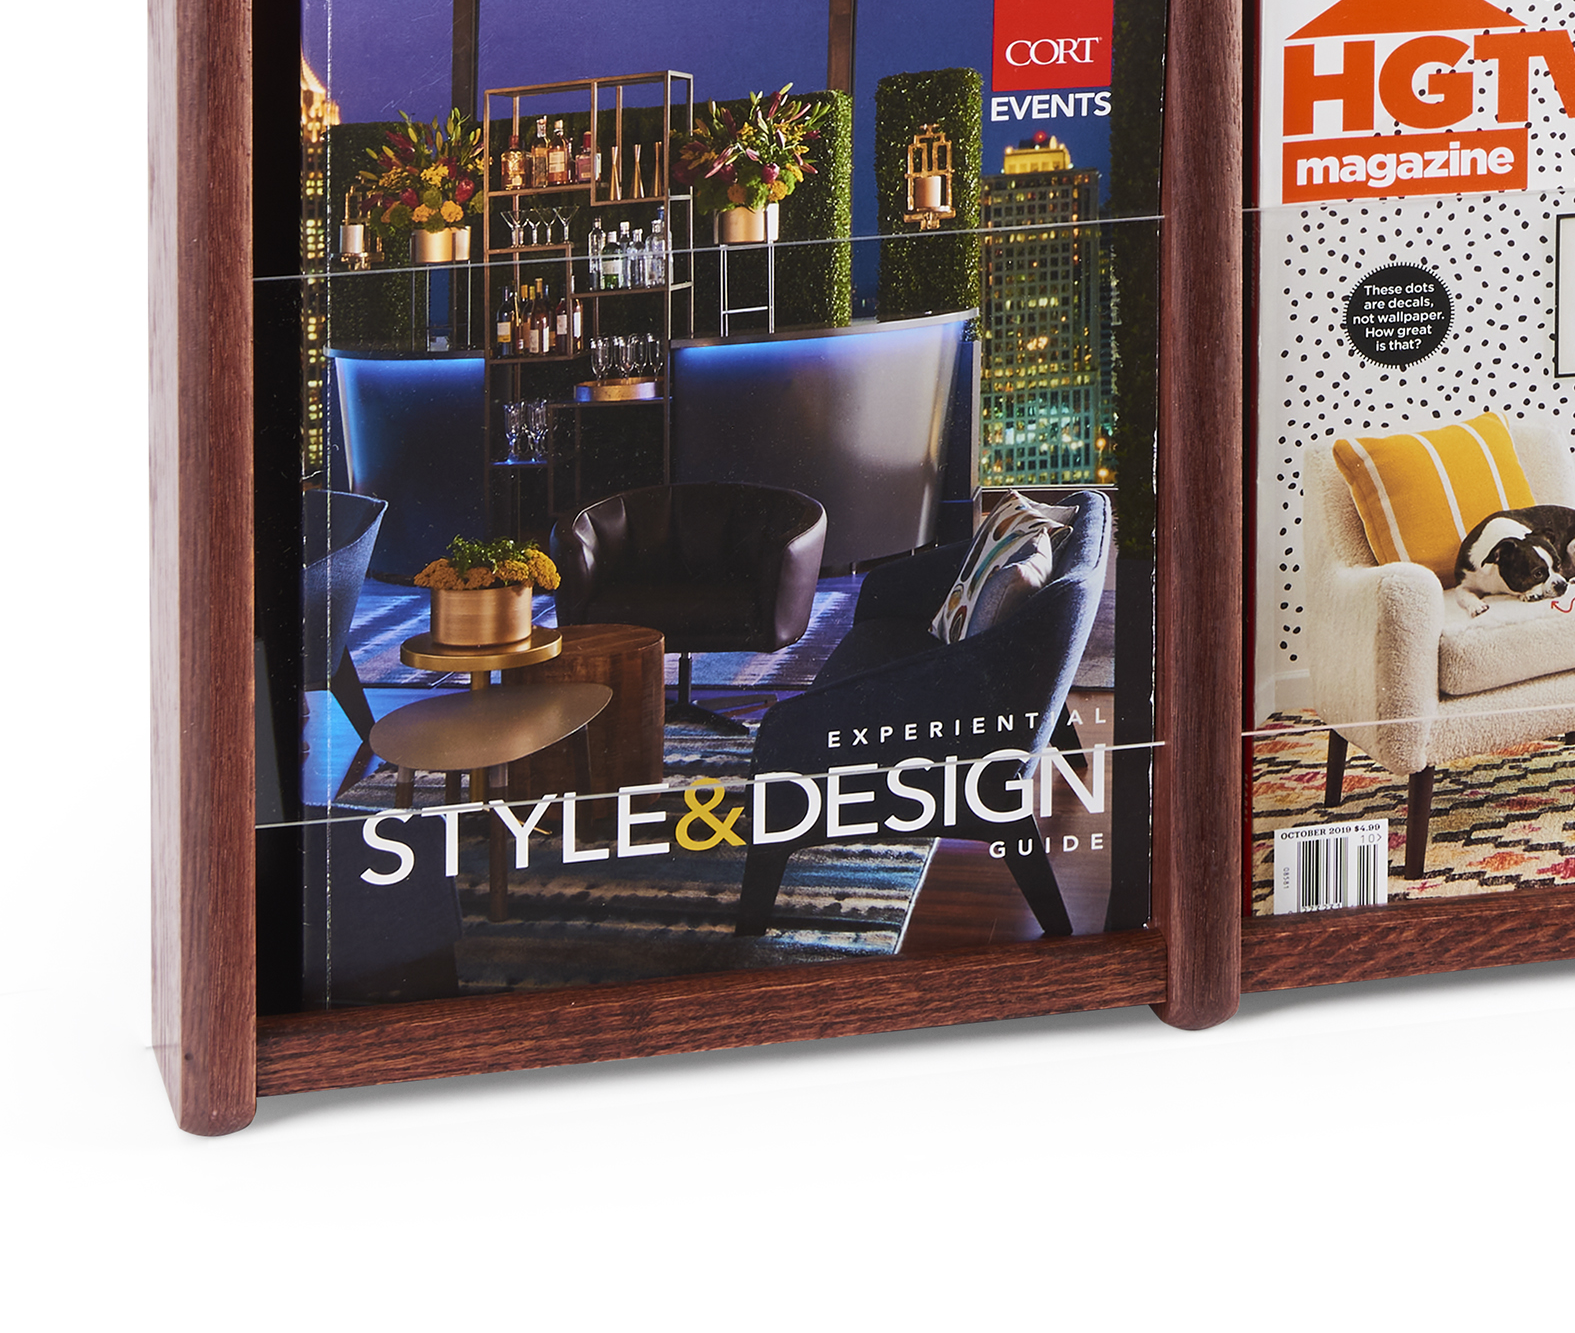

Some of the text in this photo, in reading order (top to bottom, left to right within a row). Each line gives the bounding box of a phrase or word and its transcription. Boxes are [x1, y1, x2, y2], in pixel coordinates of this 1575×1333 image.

[1006, 37, 1099, 66] CORT
[991, 92, 1111, 121] EVENTS
[1296, 140, 1515, 189] magazine
[1364, 283, 1434, 295] These dots
[360, 743, 1106, 887] STYLE&DESIGN
[989, 832, 1106, 859] GUIDE
[1281, 824, 1380, 840] OCTOBER 2019 $4.99
